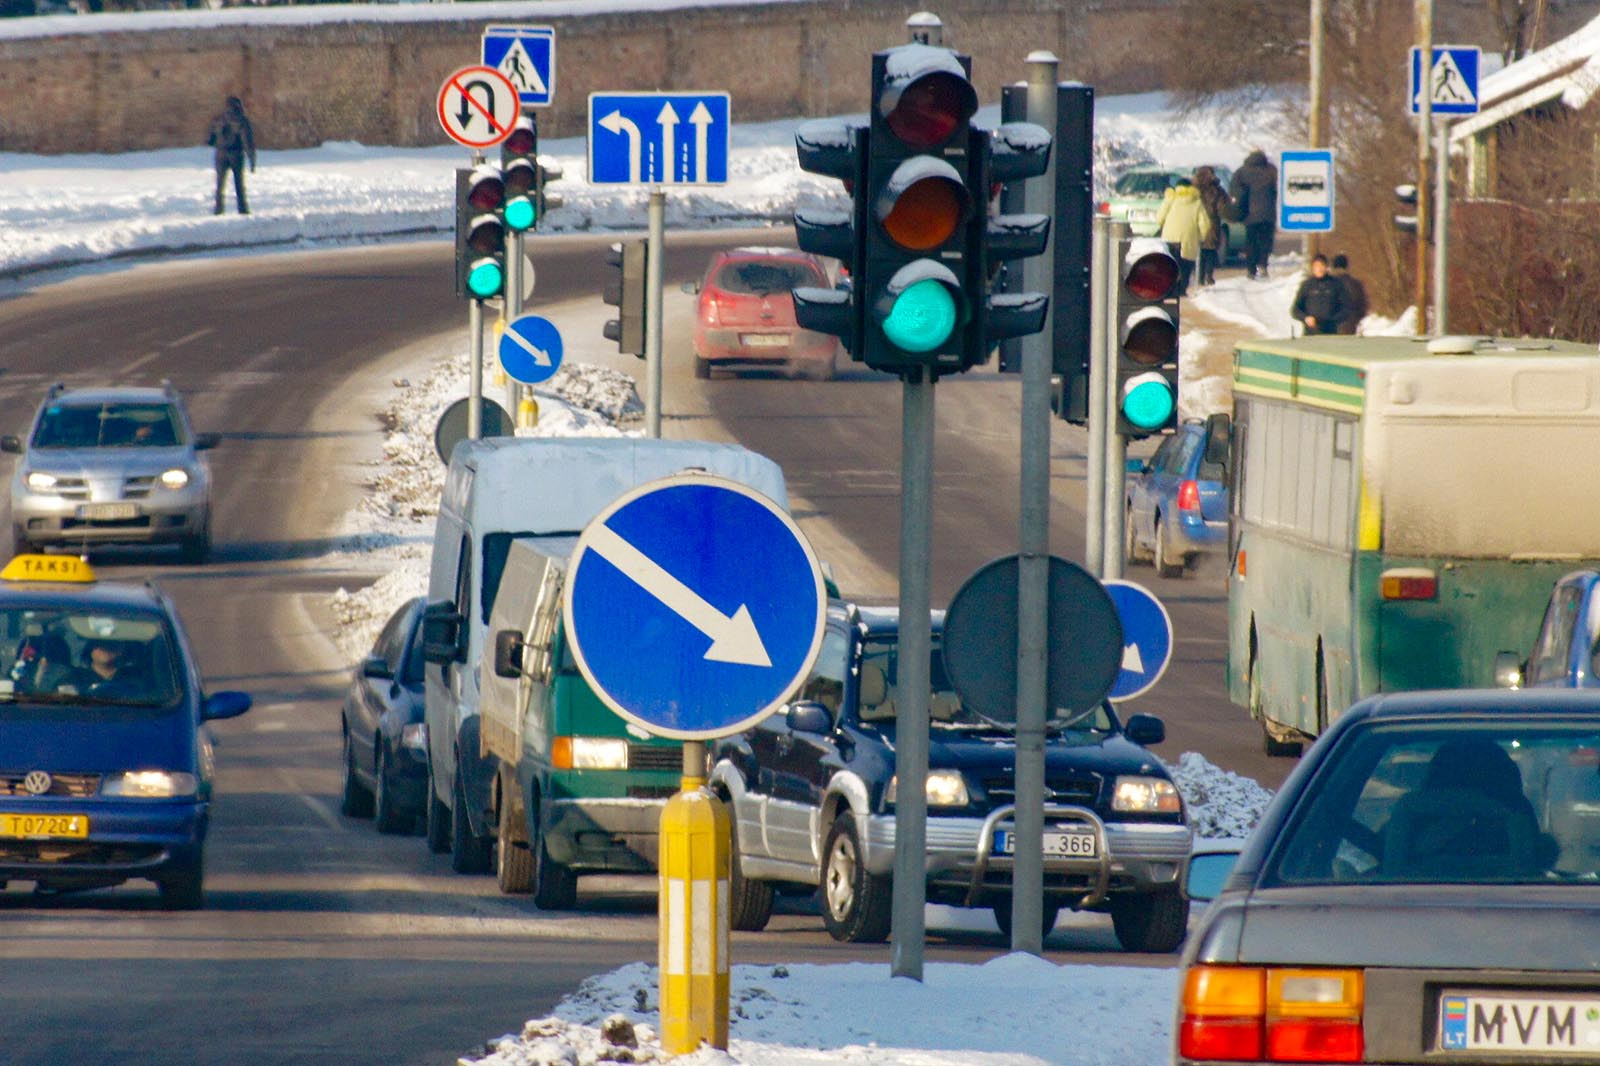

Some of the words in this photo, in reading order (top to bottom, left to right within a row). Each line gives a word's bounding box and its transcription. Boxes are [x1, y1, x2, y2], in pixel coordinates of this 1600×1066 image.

[23, 560, 78, 574] TAKSI
[1474, 1003, 1576, 1046] MVM
[1446, 1033, 1465, 1045] LT
